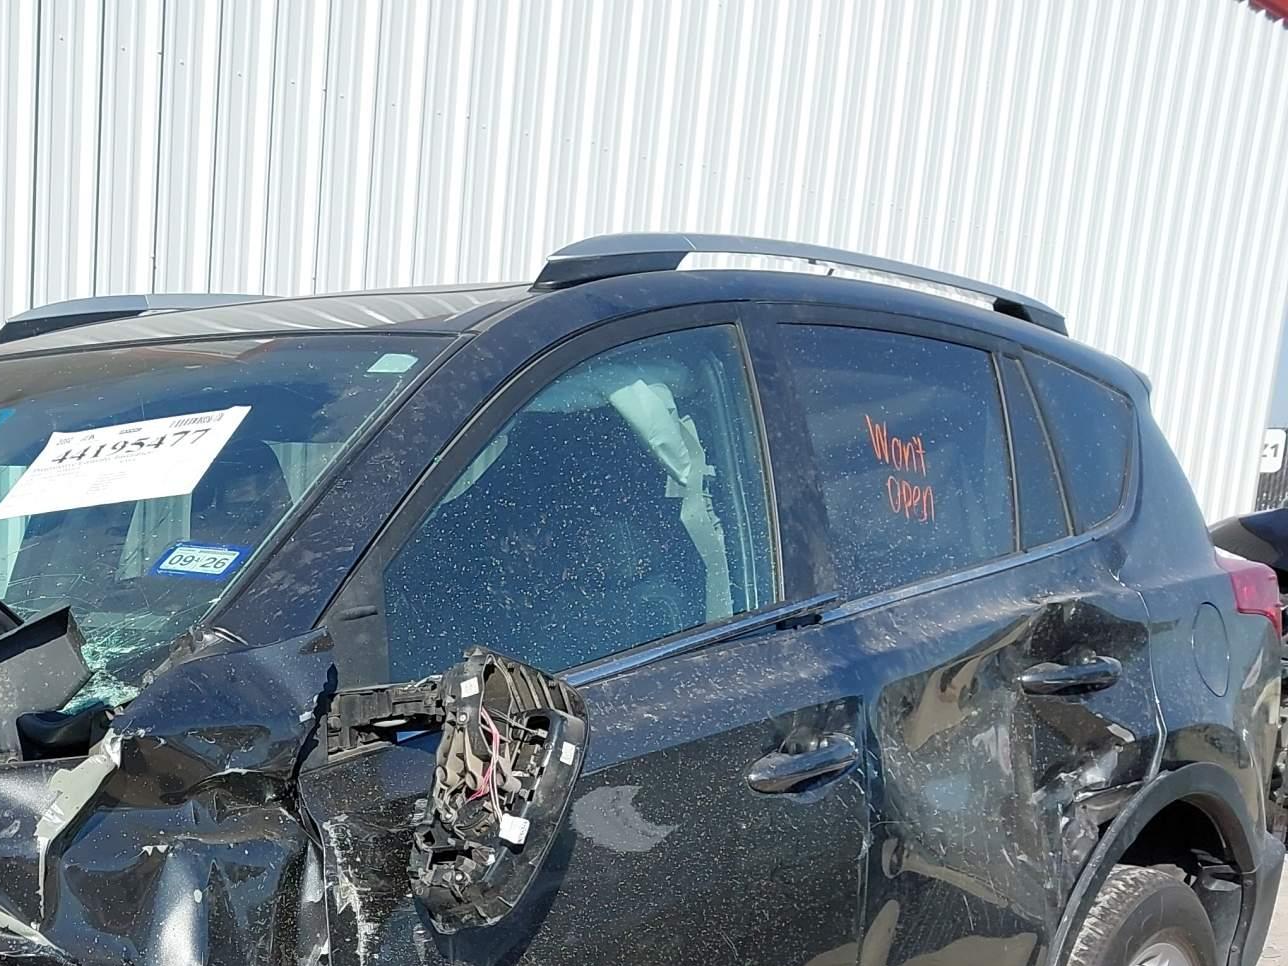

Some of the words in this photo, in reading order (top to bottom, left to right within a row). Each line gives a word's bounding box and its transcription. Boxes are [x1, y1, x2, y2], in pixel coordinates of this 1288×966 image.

[51, 427, 213, 465] 44195477
[168, 554, 195, 567] 09
[199, 557, 230, 569] 26
